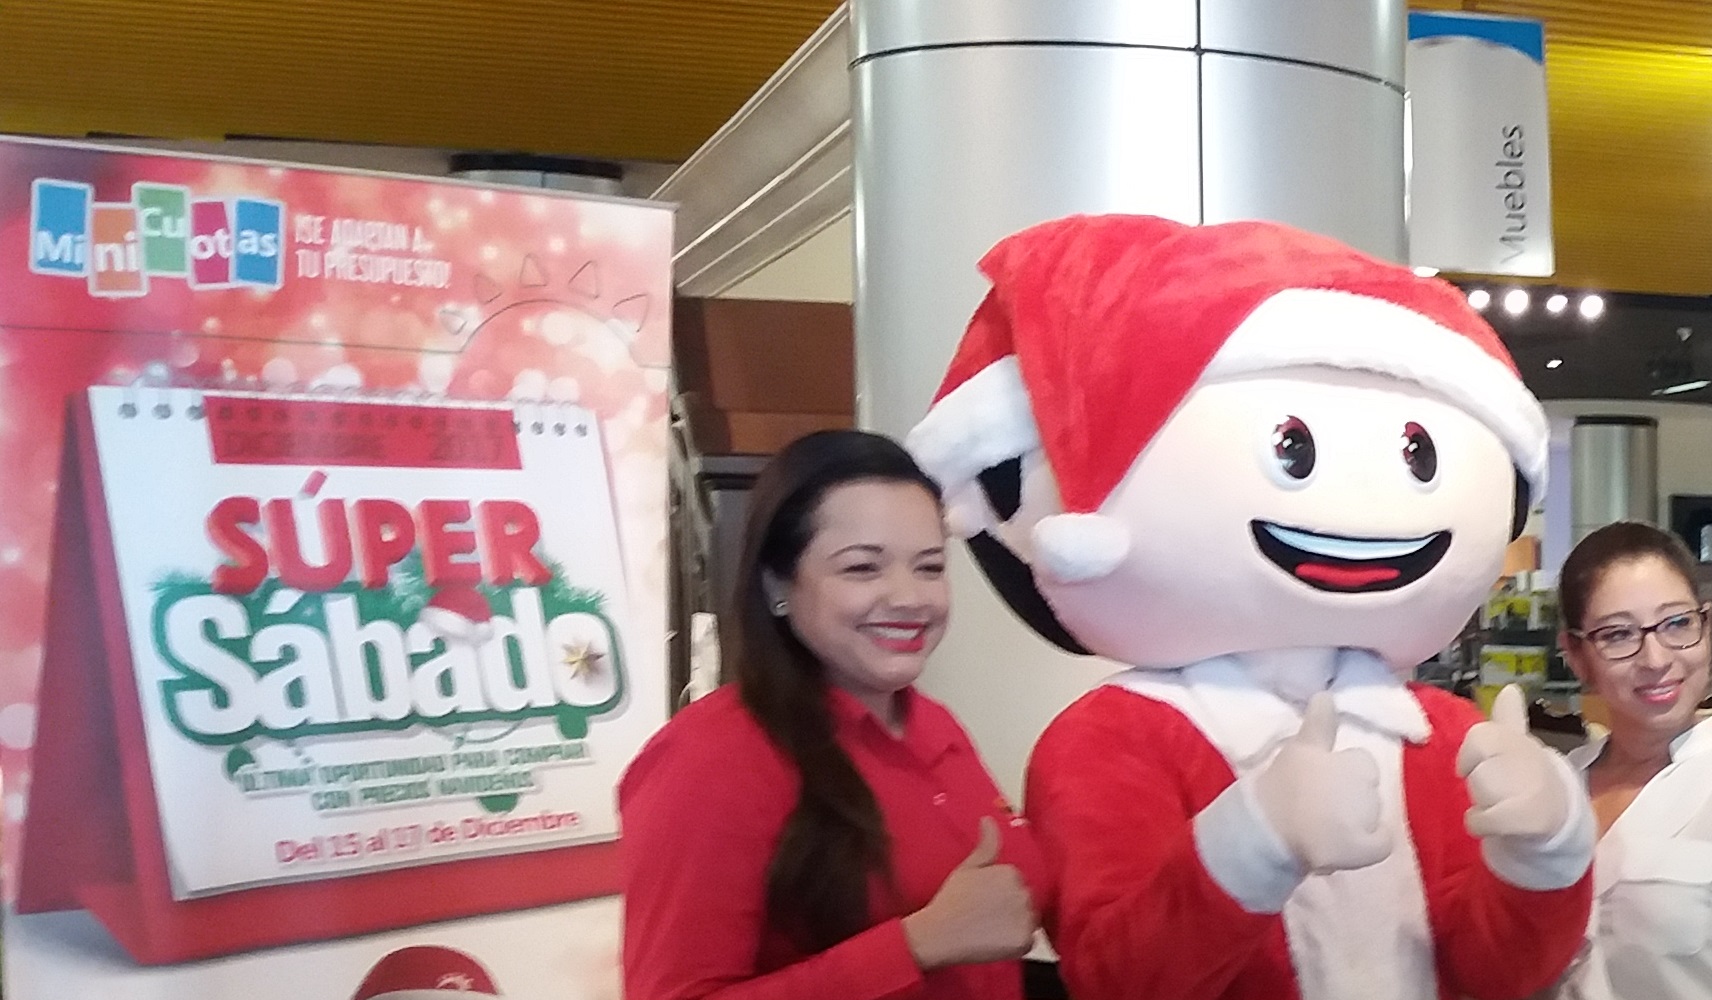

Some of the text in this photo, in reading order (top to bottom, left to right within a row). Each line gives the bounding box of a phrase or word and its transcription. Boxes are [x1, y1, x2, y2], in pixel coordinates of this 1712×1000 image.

[1495, 124, 1528, 264] Muebles
[203, 470, 556, 594] SÚPER
[164, 588, 618, 736] Sábado
[275, 836, 323, 863] Del
[329, 831, 362, 858] 15
[366, 827, 388, 851] al
[427, 820, 457, 843] de
[461, 810, 580, 840] Diciembre
